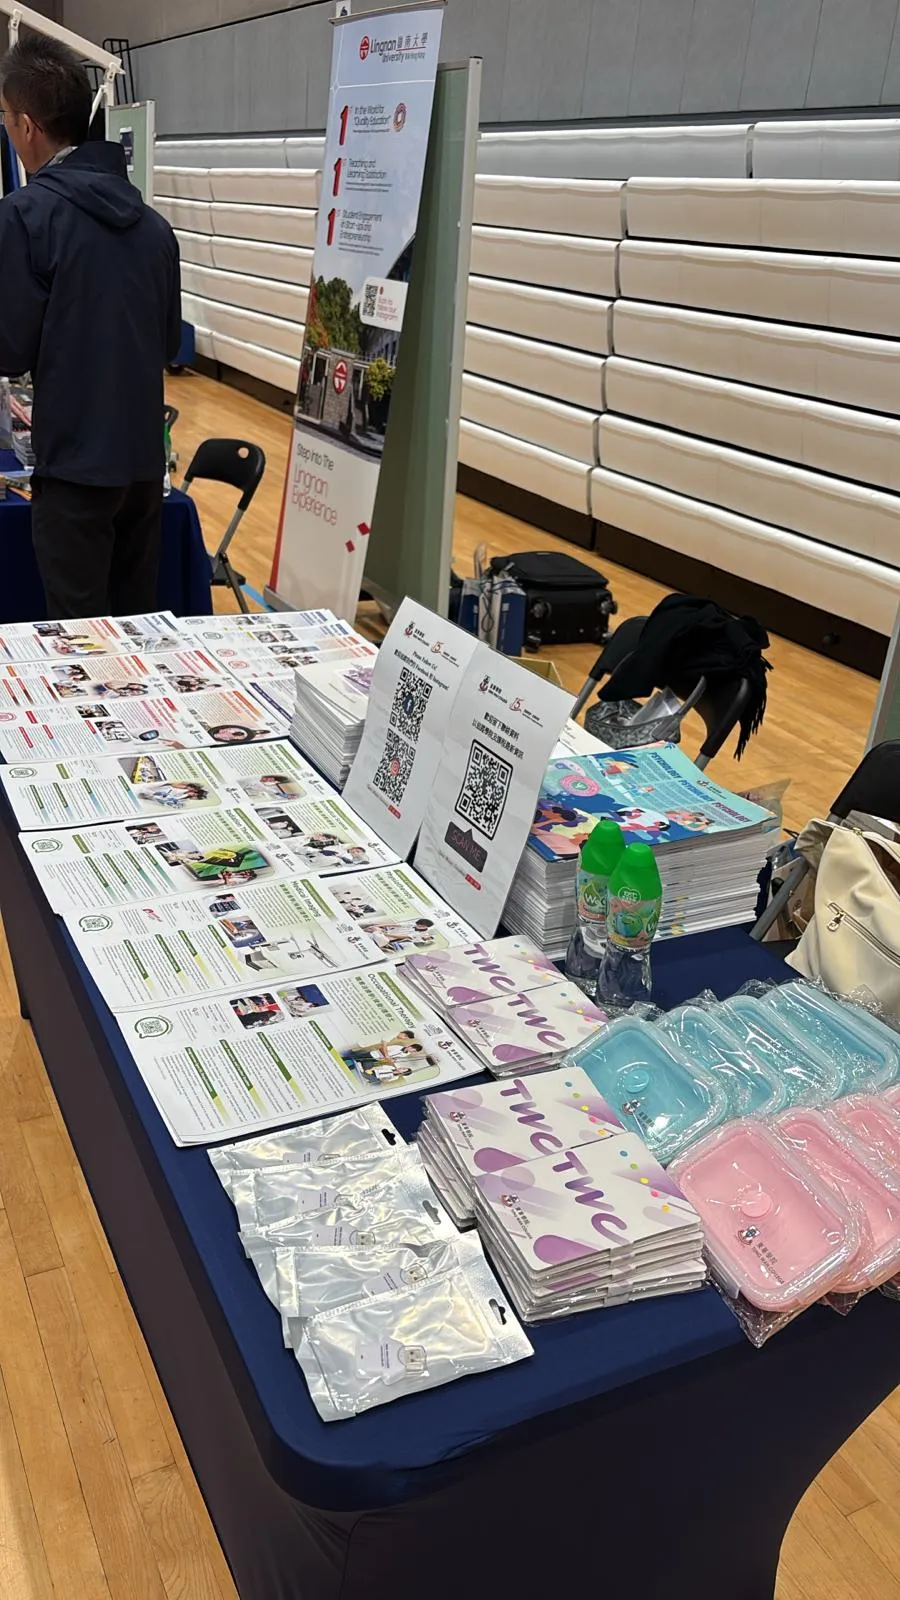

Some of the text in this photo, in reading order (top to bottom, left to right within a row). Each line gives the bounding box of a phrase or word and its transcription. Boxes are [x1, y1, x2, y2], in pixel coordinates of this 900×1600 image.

[370, 39, 396, 56] Lingnan
[296, 443, 310, 463] Step
[323, 454, 335, 471] The
[294, 463, 328, 498] Lingnan
[292, 485, 337, 526] Experience
[291, 880, 306, 899] Medical
[304, 898, 321, 918] Imaging
[368, 973, 398, 1007] Occupational
[395, 1004, 417, 1030] Therapy
[508, 993, 568, 1050] TWC
[500, 1079, 564, 1156] TWC
[552, 1151, 631, 1247] TWC
